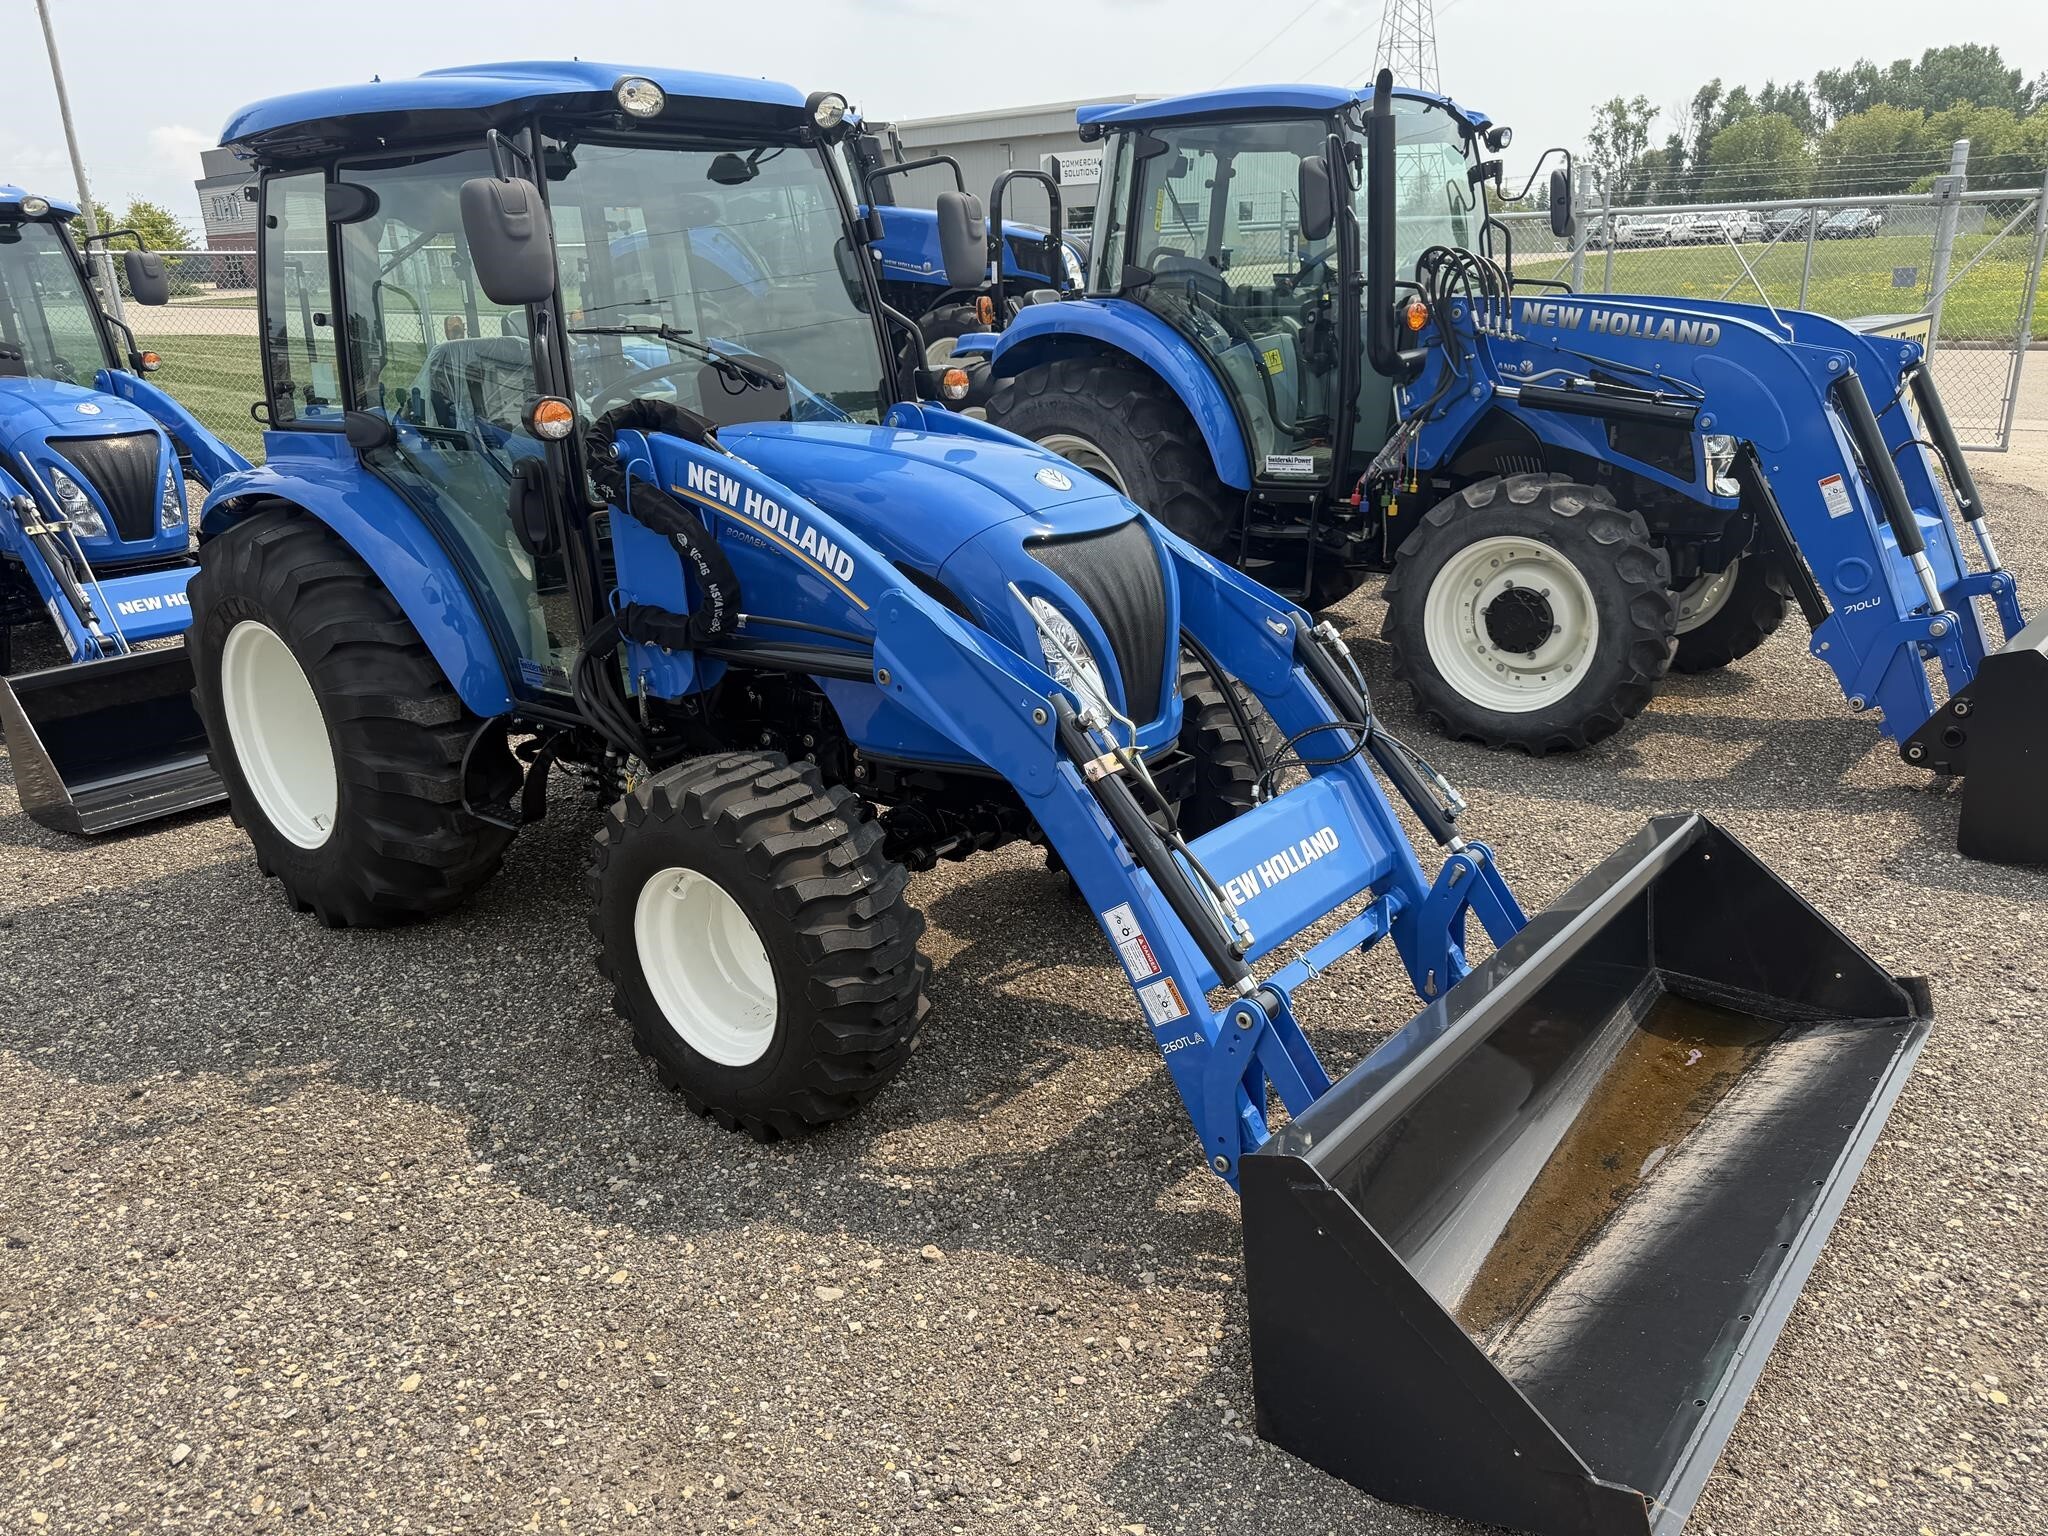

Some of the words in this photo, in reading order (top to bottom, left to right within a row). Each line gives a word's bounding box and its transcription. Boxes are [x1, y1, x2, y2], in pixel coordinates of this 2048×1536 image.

[1064, 167, 1099, 177] SOLUTIONS
[1521, 301, 1584, 330] NEW
[1588, 309, 1721, 347] HOLLAND
[687, 461, 741, 507] NEW
[744, 488, 855, 582] HOLLAND
[117, 595, 163, 616] NEW
[1844, 597, 1881, 615] 710LU
[1256, 826, 1340, 889] HOLLAND
